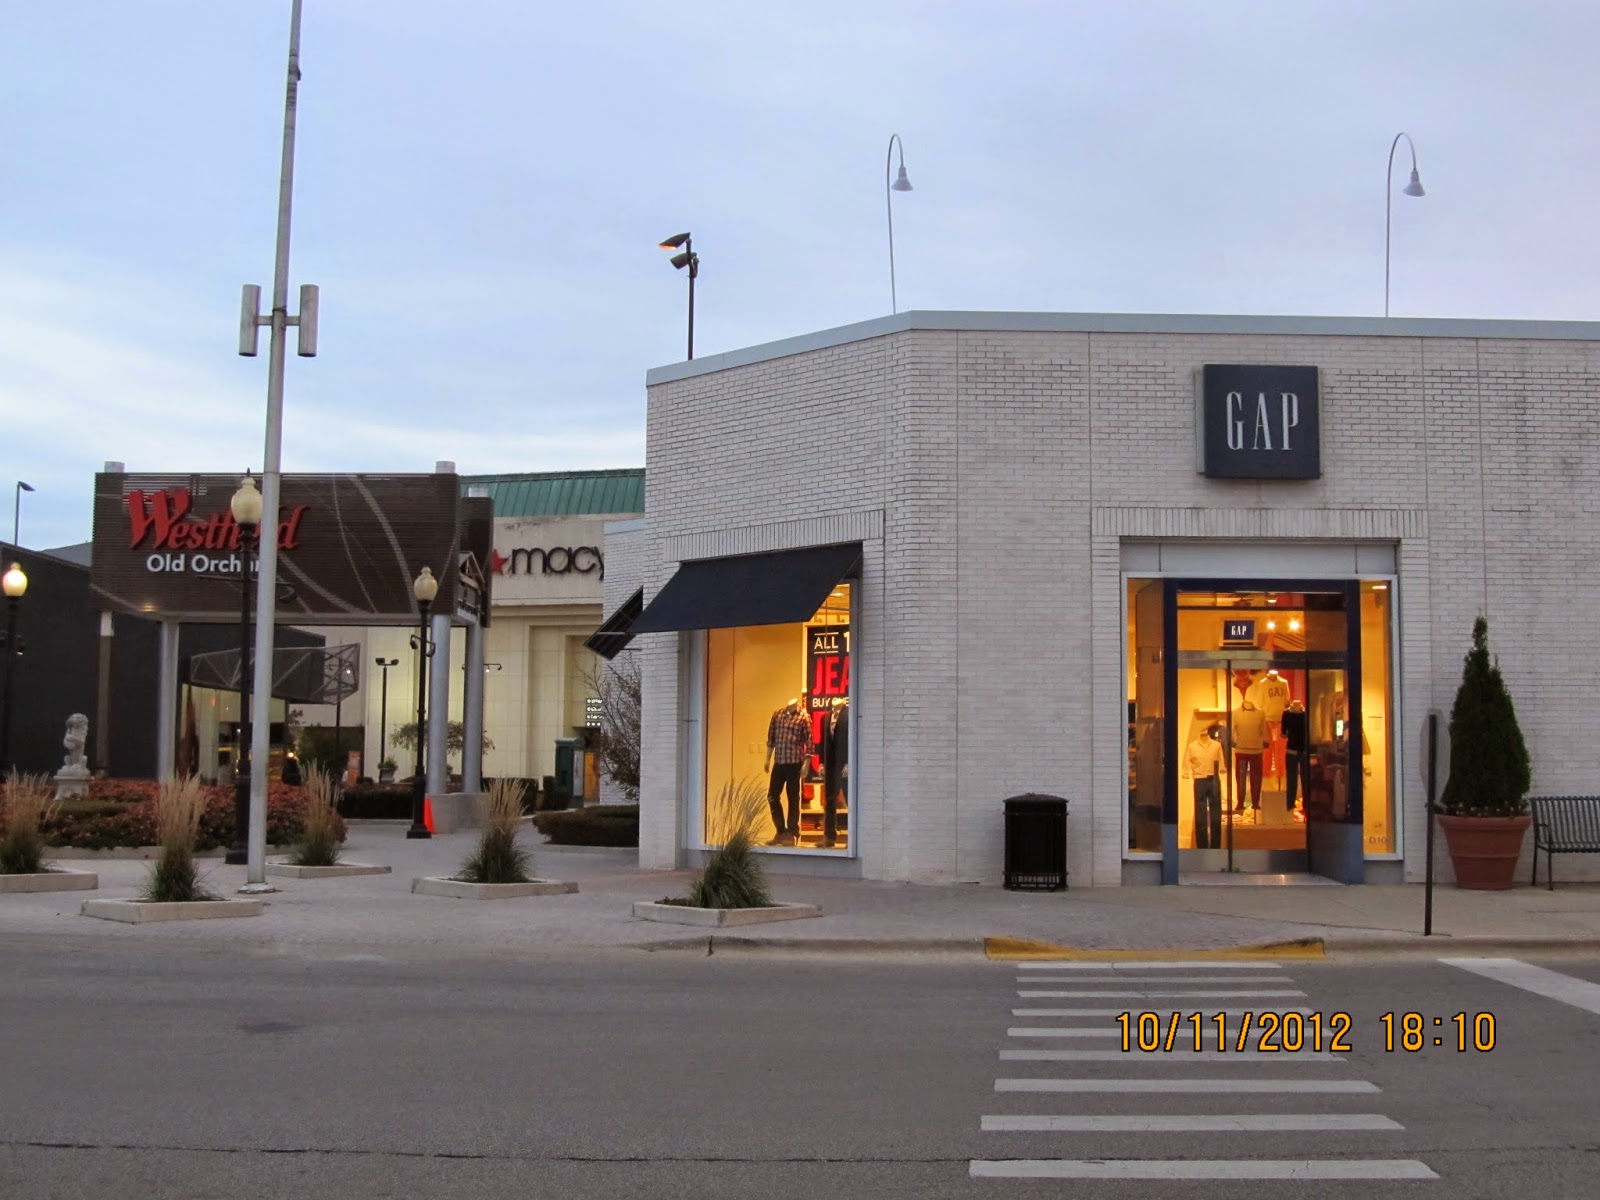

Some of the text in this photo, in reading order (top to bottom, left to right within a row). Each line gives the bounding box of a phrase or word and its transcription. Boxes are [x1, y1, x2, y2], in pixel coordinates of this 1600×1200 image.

[1226, 391, 1300, 451] GAP
[147, 554, 185, 572] Old
[1231, 625, 1247, 636] GAP
[814, 636, 839, 650] ALL
[812, 697, 830, 708] BUY
